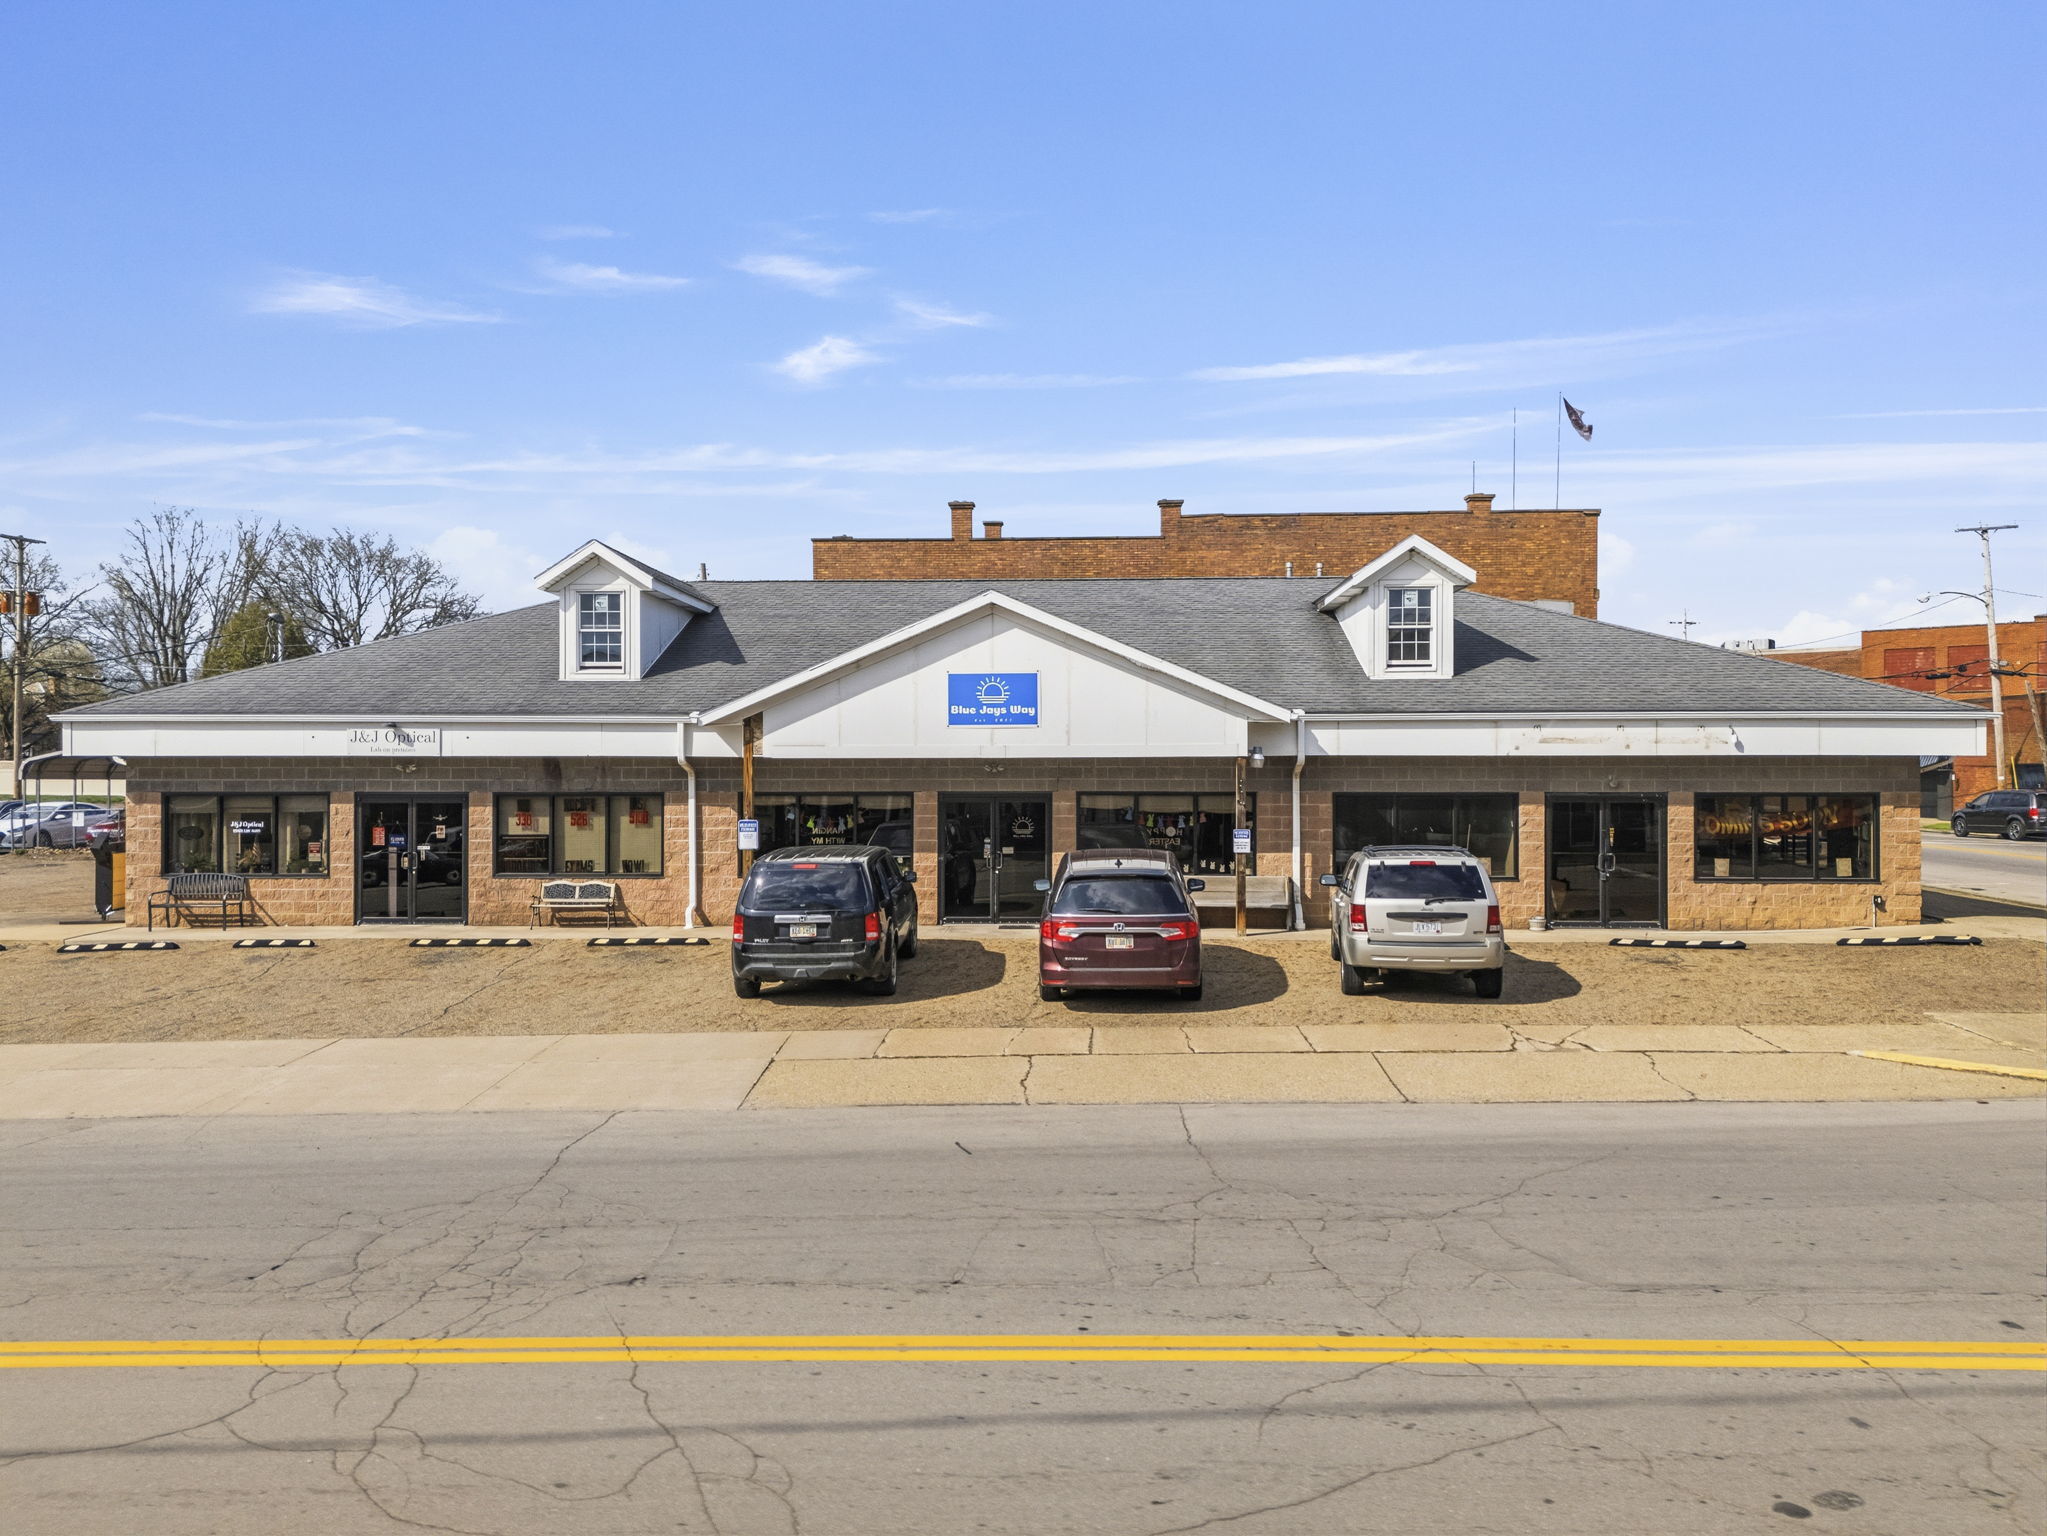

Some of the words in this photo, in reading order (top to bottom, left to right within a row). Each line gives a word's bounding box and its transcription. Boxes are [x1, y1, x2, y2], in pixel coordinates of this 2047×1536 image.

[950, 705, 977, 714] Blue
[979, 705, 1007, 716] Jays
[1009, 705, 1036, 716] Way
[350, 730, 378, 744] J&J
[385, 729, 436, 746] Optical
